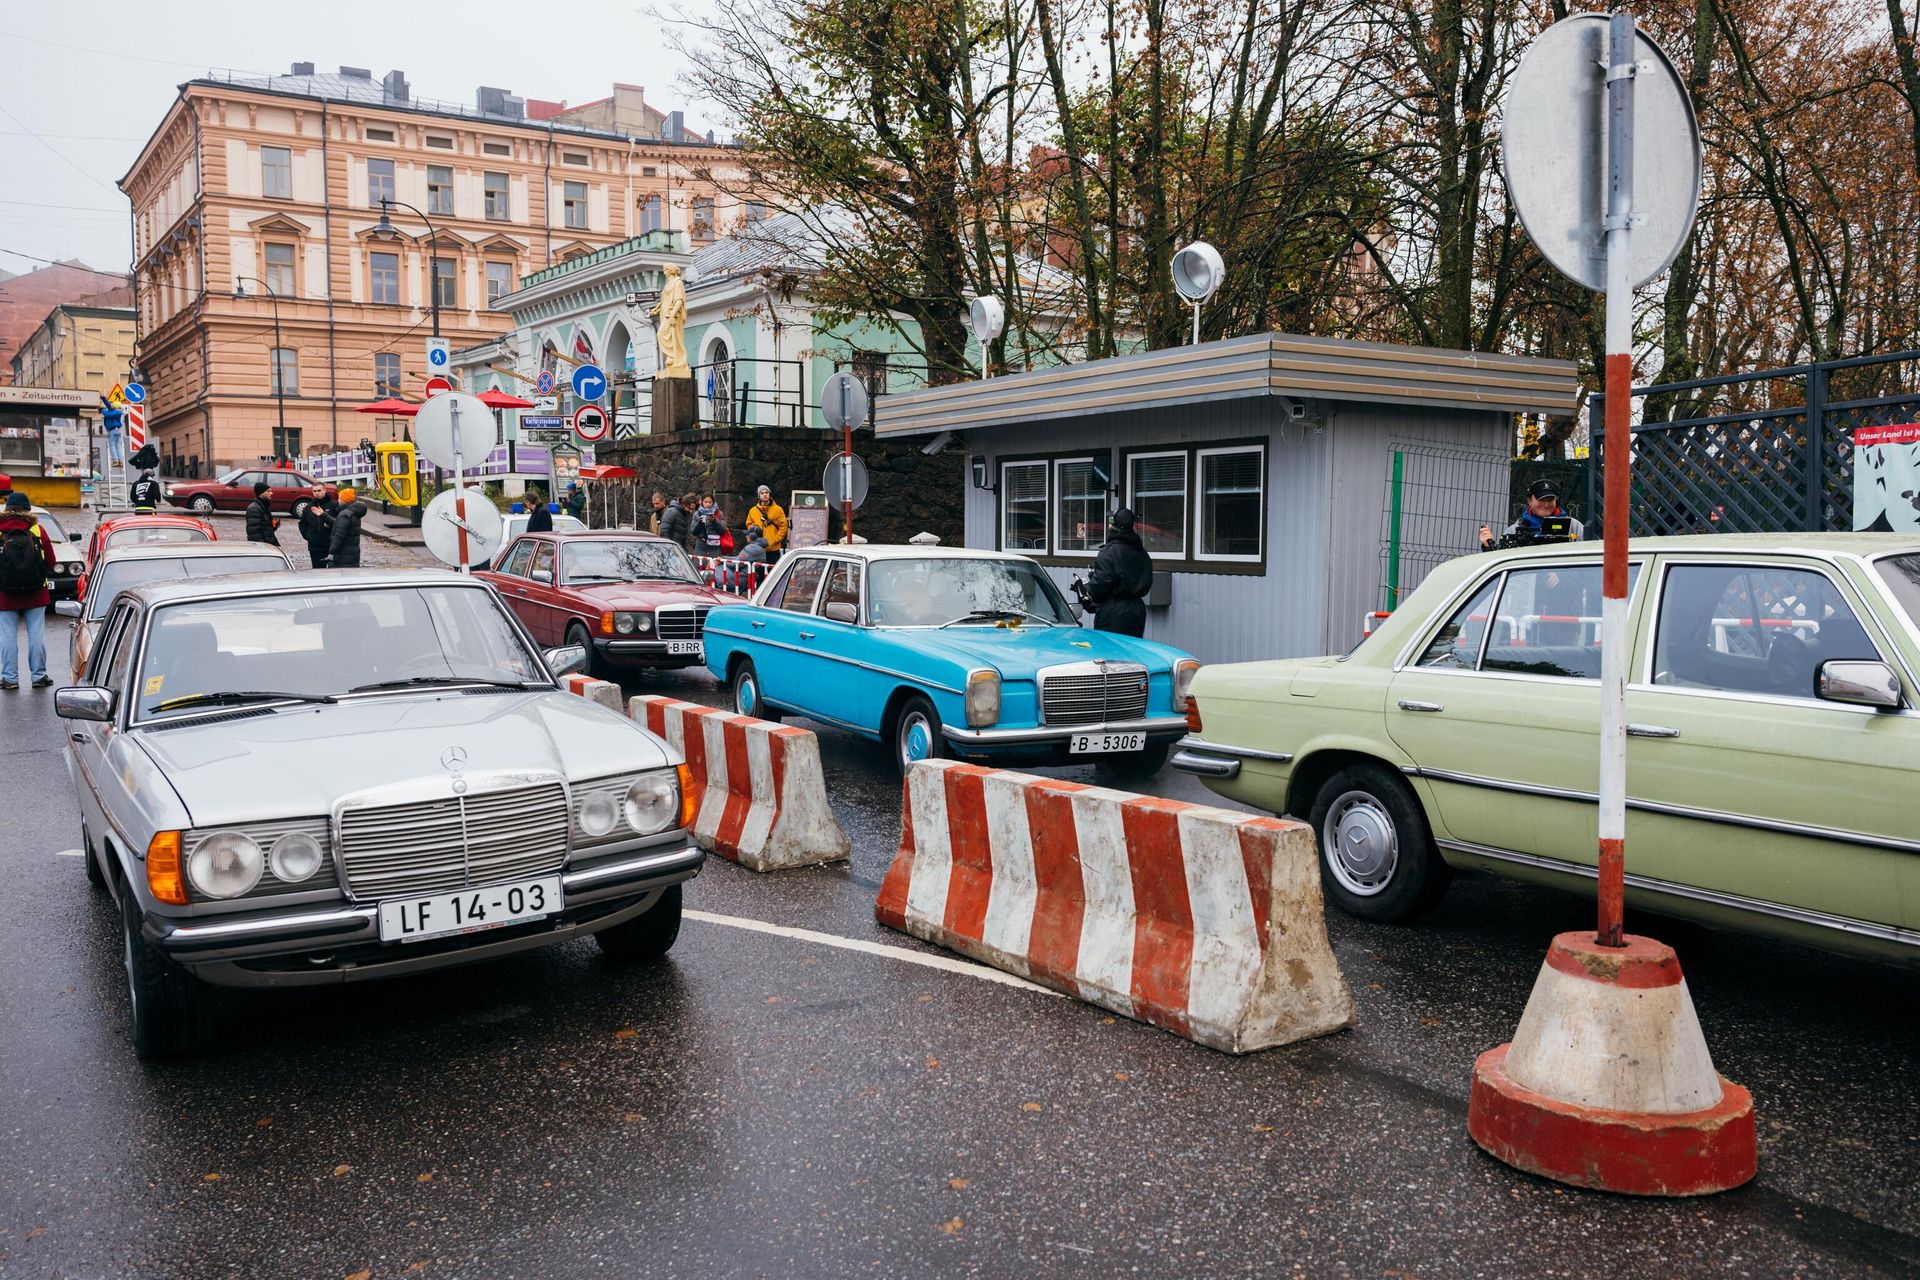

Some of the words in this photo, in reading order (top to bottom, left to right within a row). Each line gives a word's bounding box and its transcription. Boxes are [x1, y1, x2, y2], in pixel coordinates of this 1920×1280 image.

[22, 391, 82, 401] Zeitschriften
[1860, 432, 1881, 440] Unser
[1882, 429, 1902, 438] Land
[1102, 735, 1138, 751] 5306
[401, 901, 431, 934] LF
[451, 884, 545, 925] 14-03
